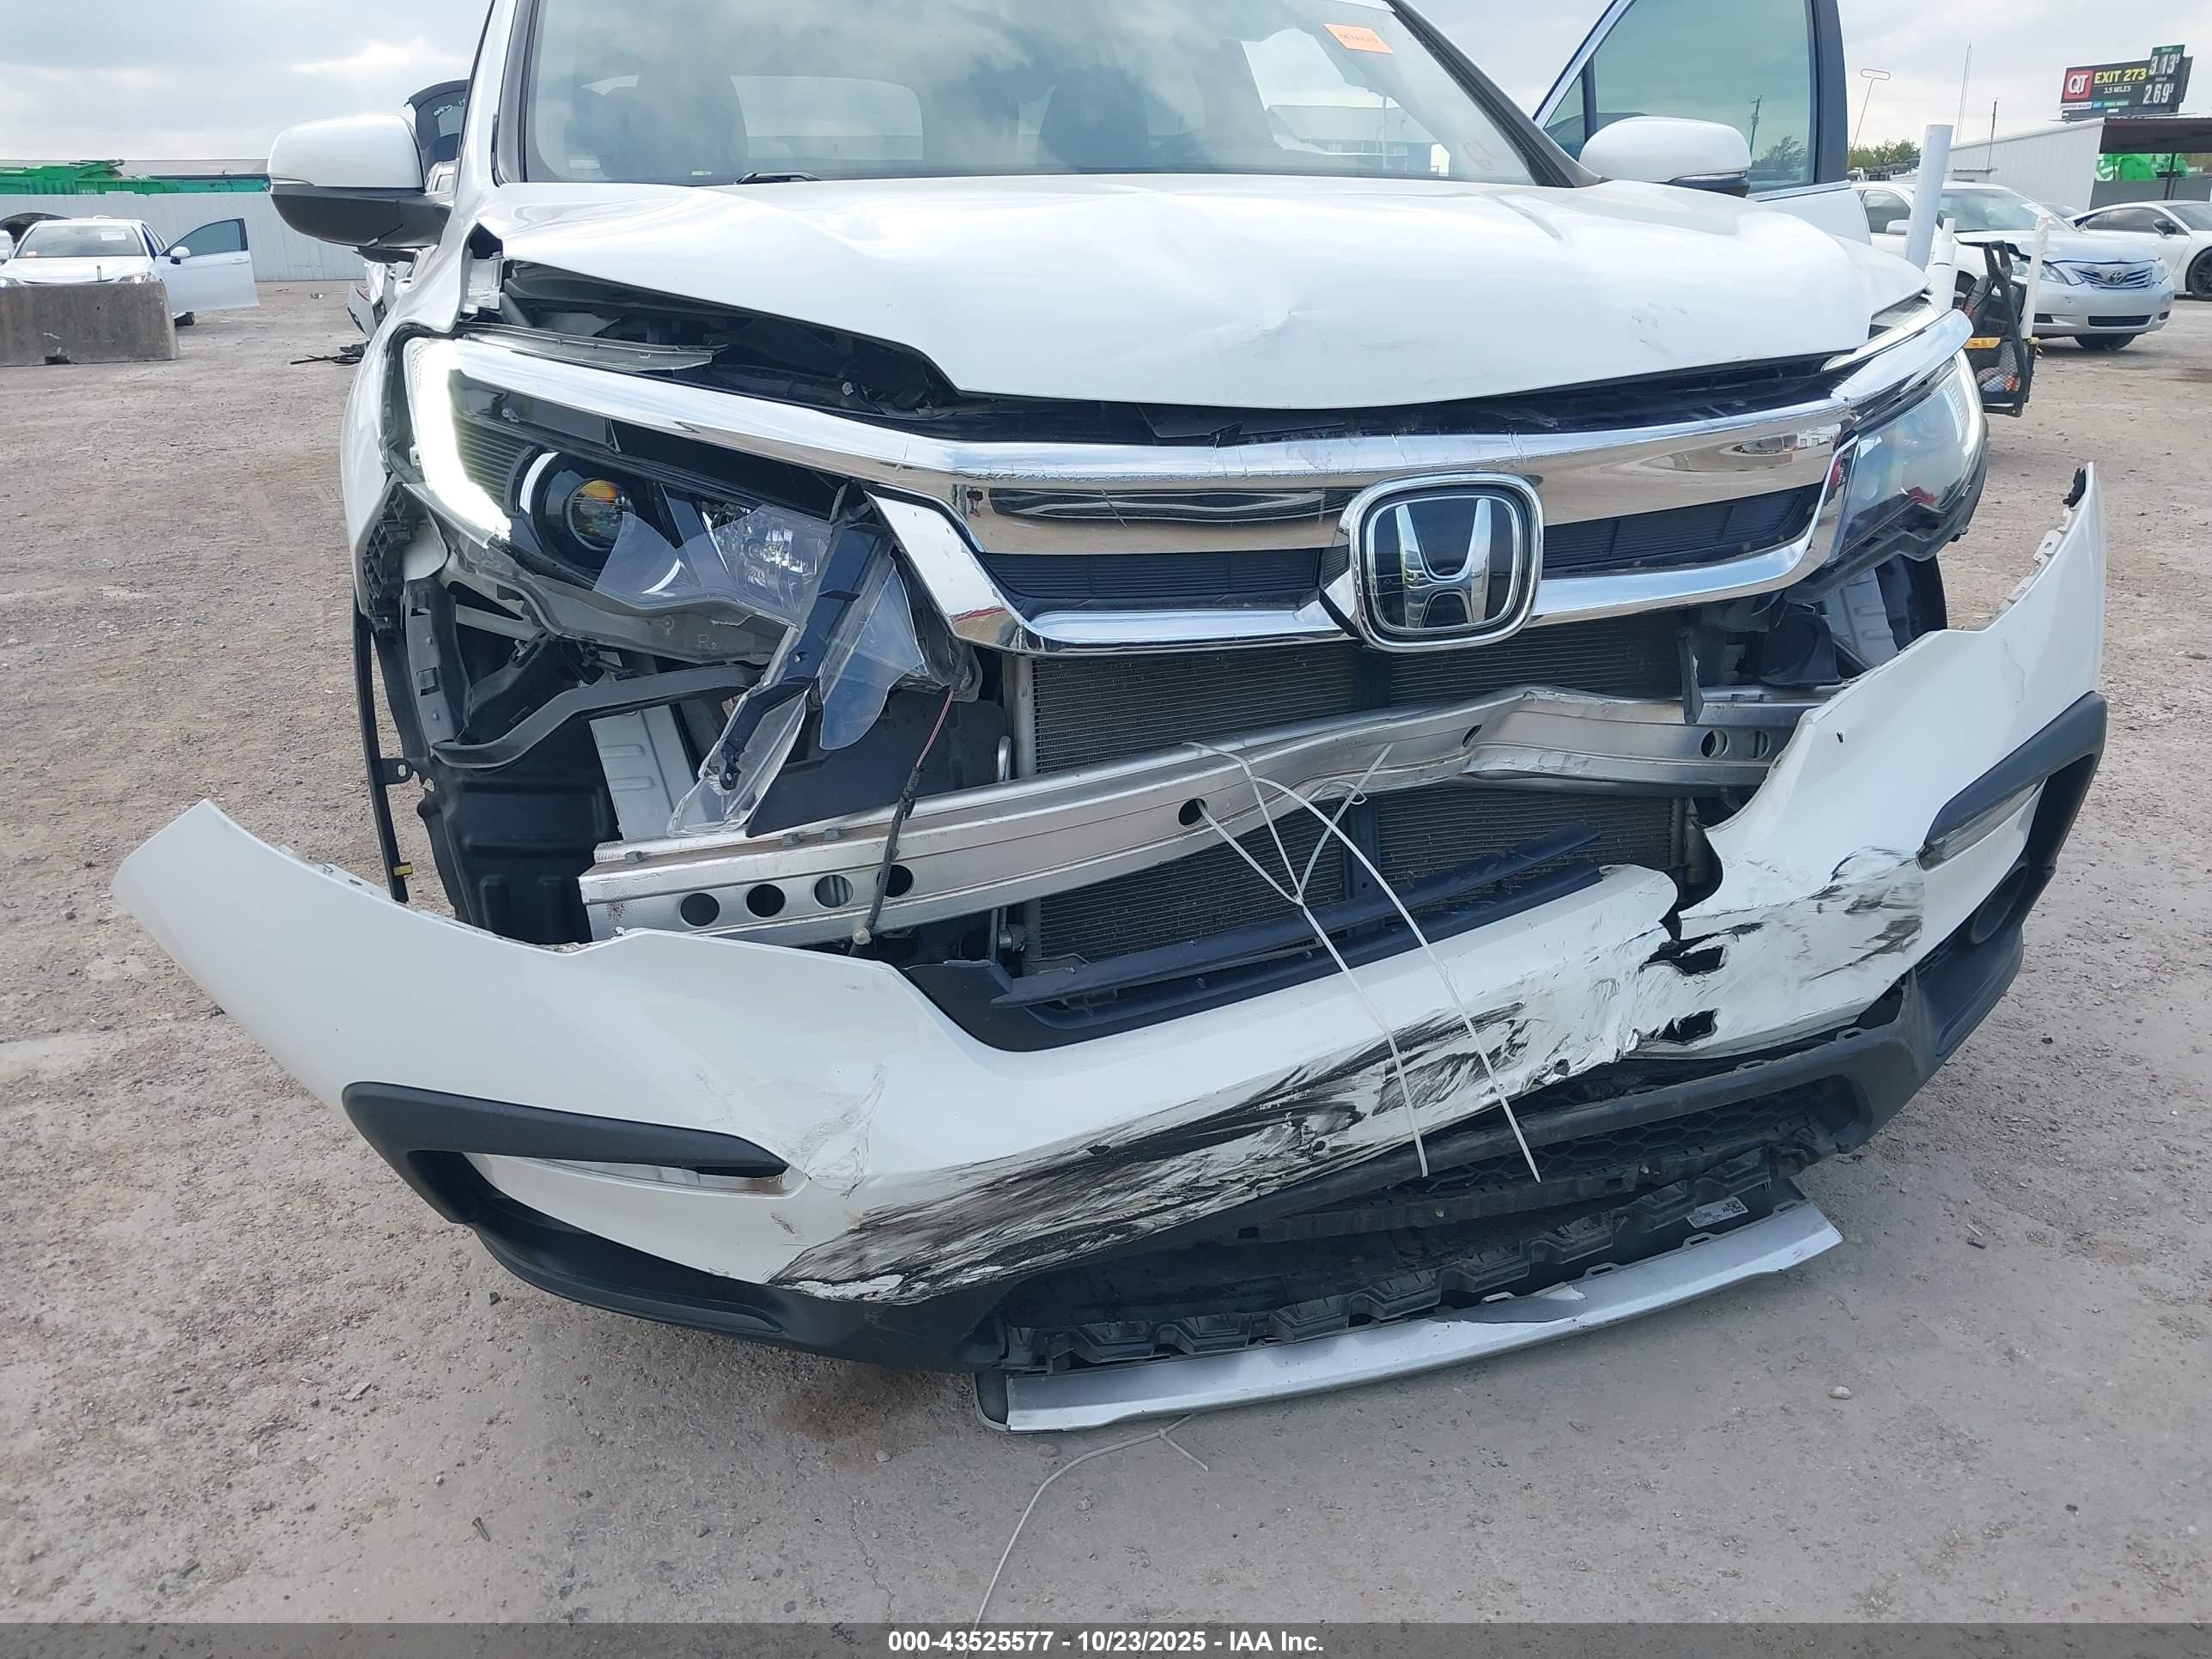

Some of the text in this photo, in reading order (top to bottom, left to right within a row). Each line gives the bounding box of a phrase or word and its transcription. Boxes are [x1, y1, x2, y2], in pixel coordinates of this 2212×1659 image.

[2068, 74, 2089, 94] QT
[2094, 67, 2147, 84] EXIT 273
